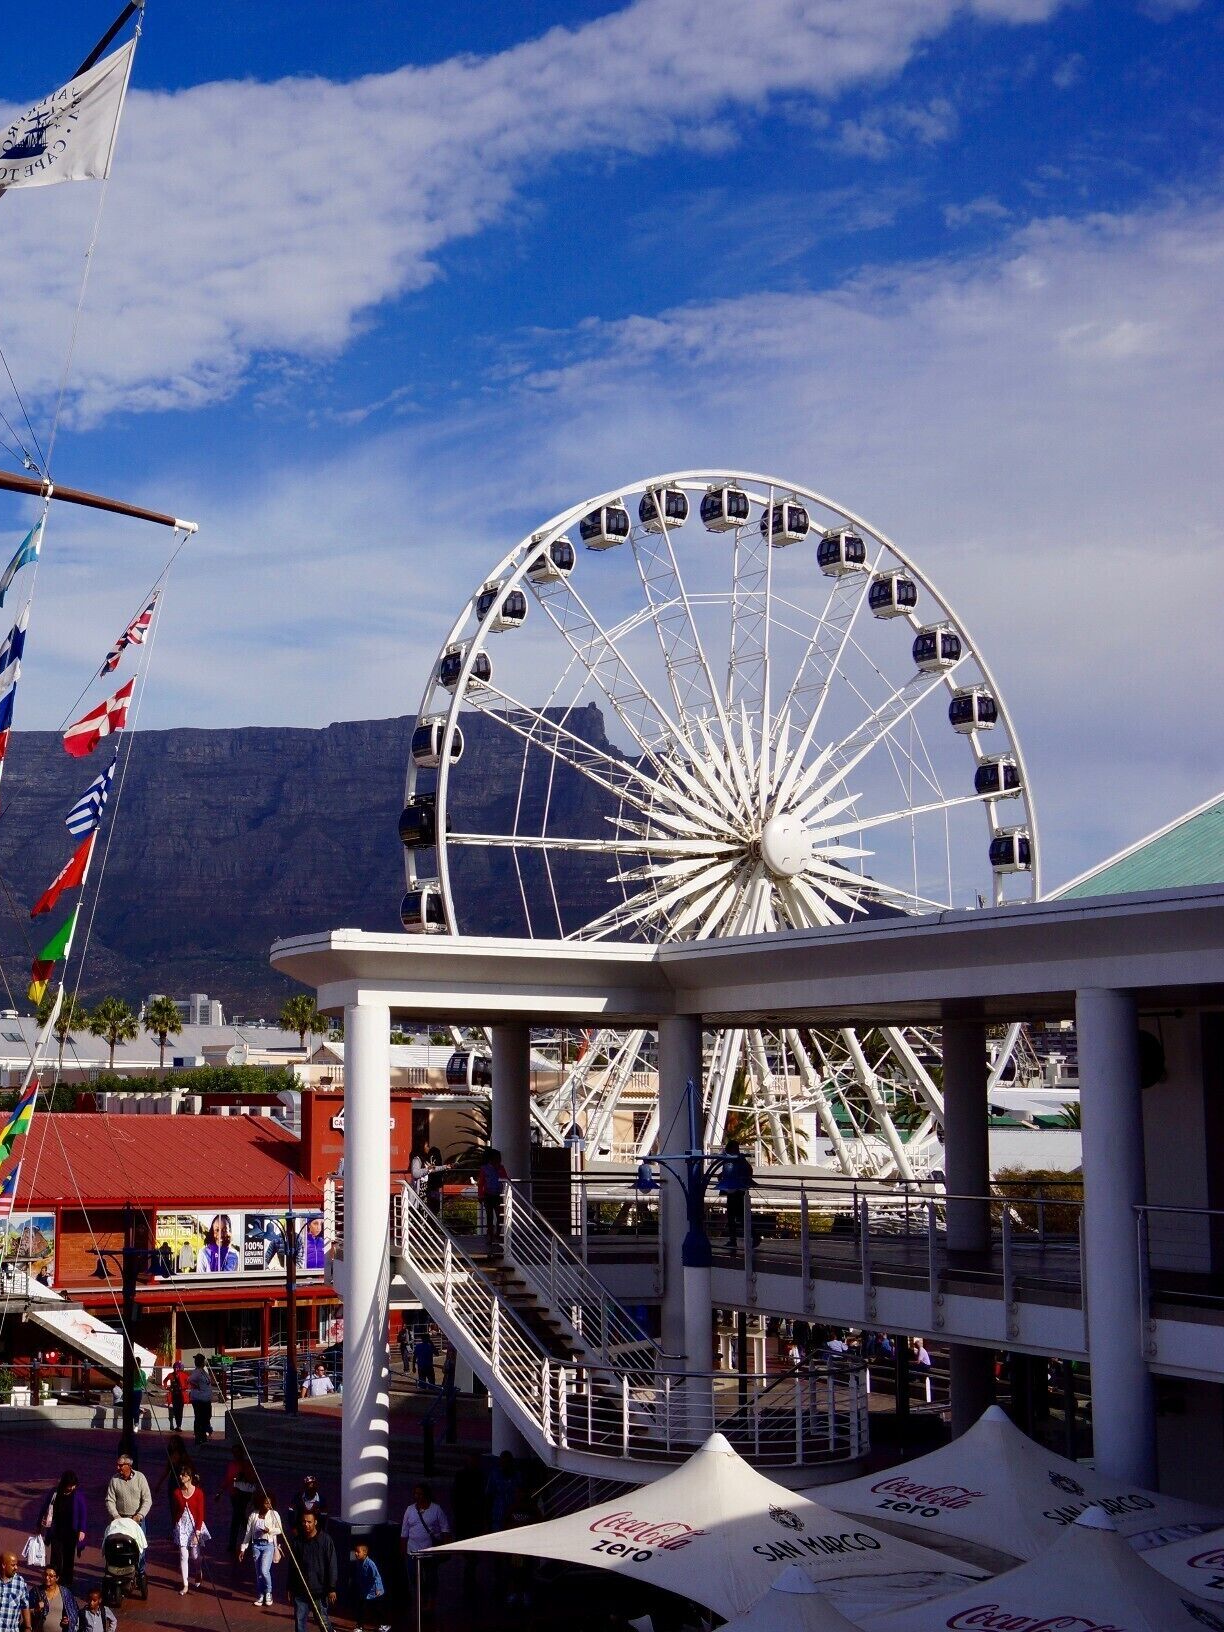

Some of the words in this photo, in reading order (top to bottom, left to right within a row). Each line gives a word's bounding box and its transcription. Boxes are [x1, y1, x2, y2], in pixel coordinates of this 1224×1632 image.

[158, 1228, 191, 1237] WINTER
[245, 1242, 264, 1250] 100%
[871, 1476, 986, 1509] Coca-Cola
[876, 1498, 940, 1518] zero
[589, 1511, 711, 1551] Coca-Cola
[590, 1539, 653, 1562] zero
[752, 1540, 806, 1562] SAN
[796, 1532, 881, 1556] MARCO
